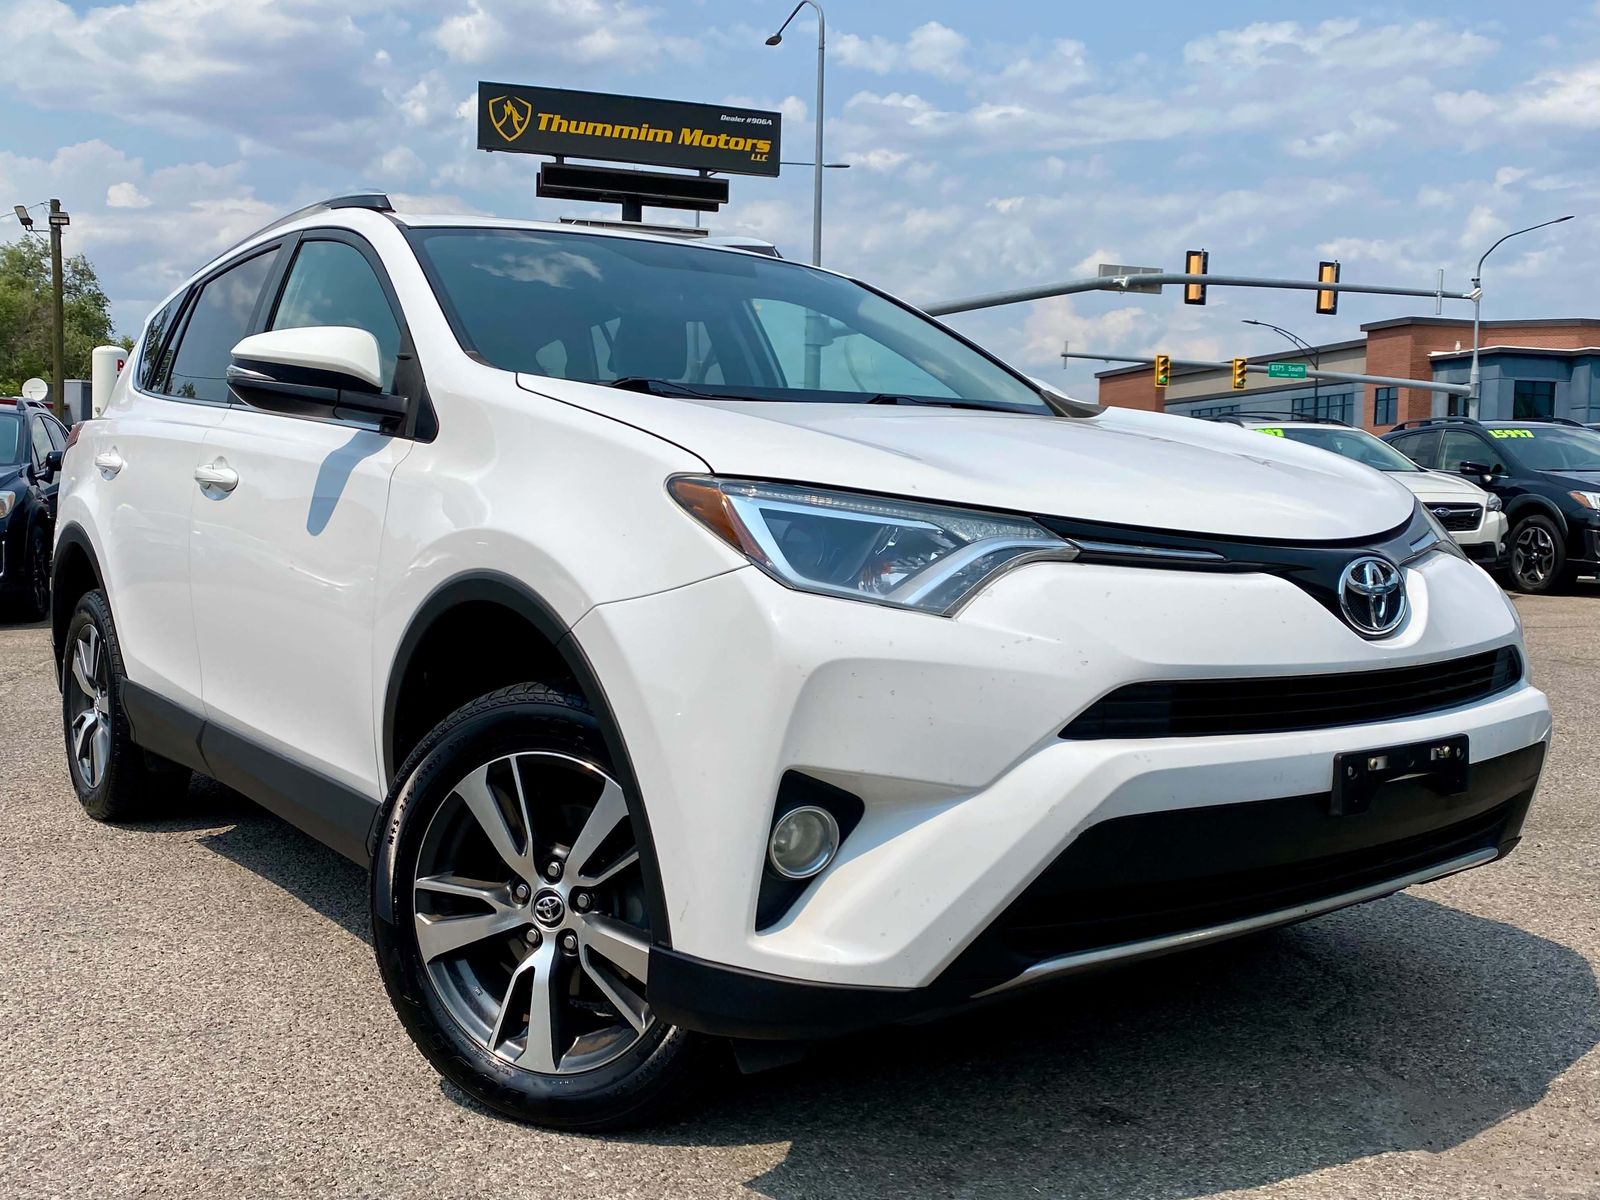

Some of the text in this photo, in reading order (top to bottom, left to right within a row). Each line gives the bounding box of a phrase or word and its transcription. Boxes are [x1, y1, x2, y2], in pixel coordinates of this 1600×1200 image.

[721, 115, 745, 123] Dealer
[537, 112, 772, 153] Thummim Motors
[751, 153, 768, 162] LLC
[1487, 429, 1535, 439] 15997
[387, 818, 400, 846] M+S
